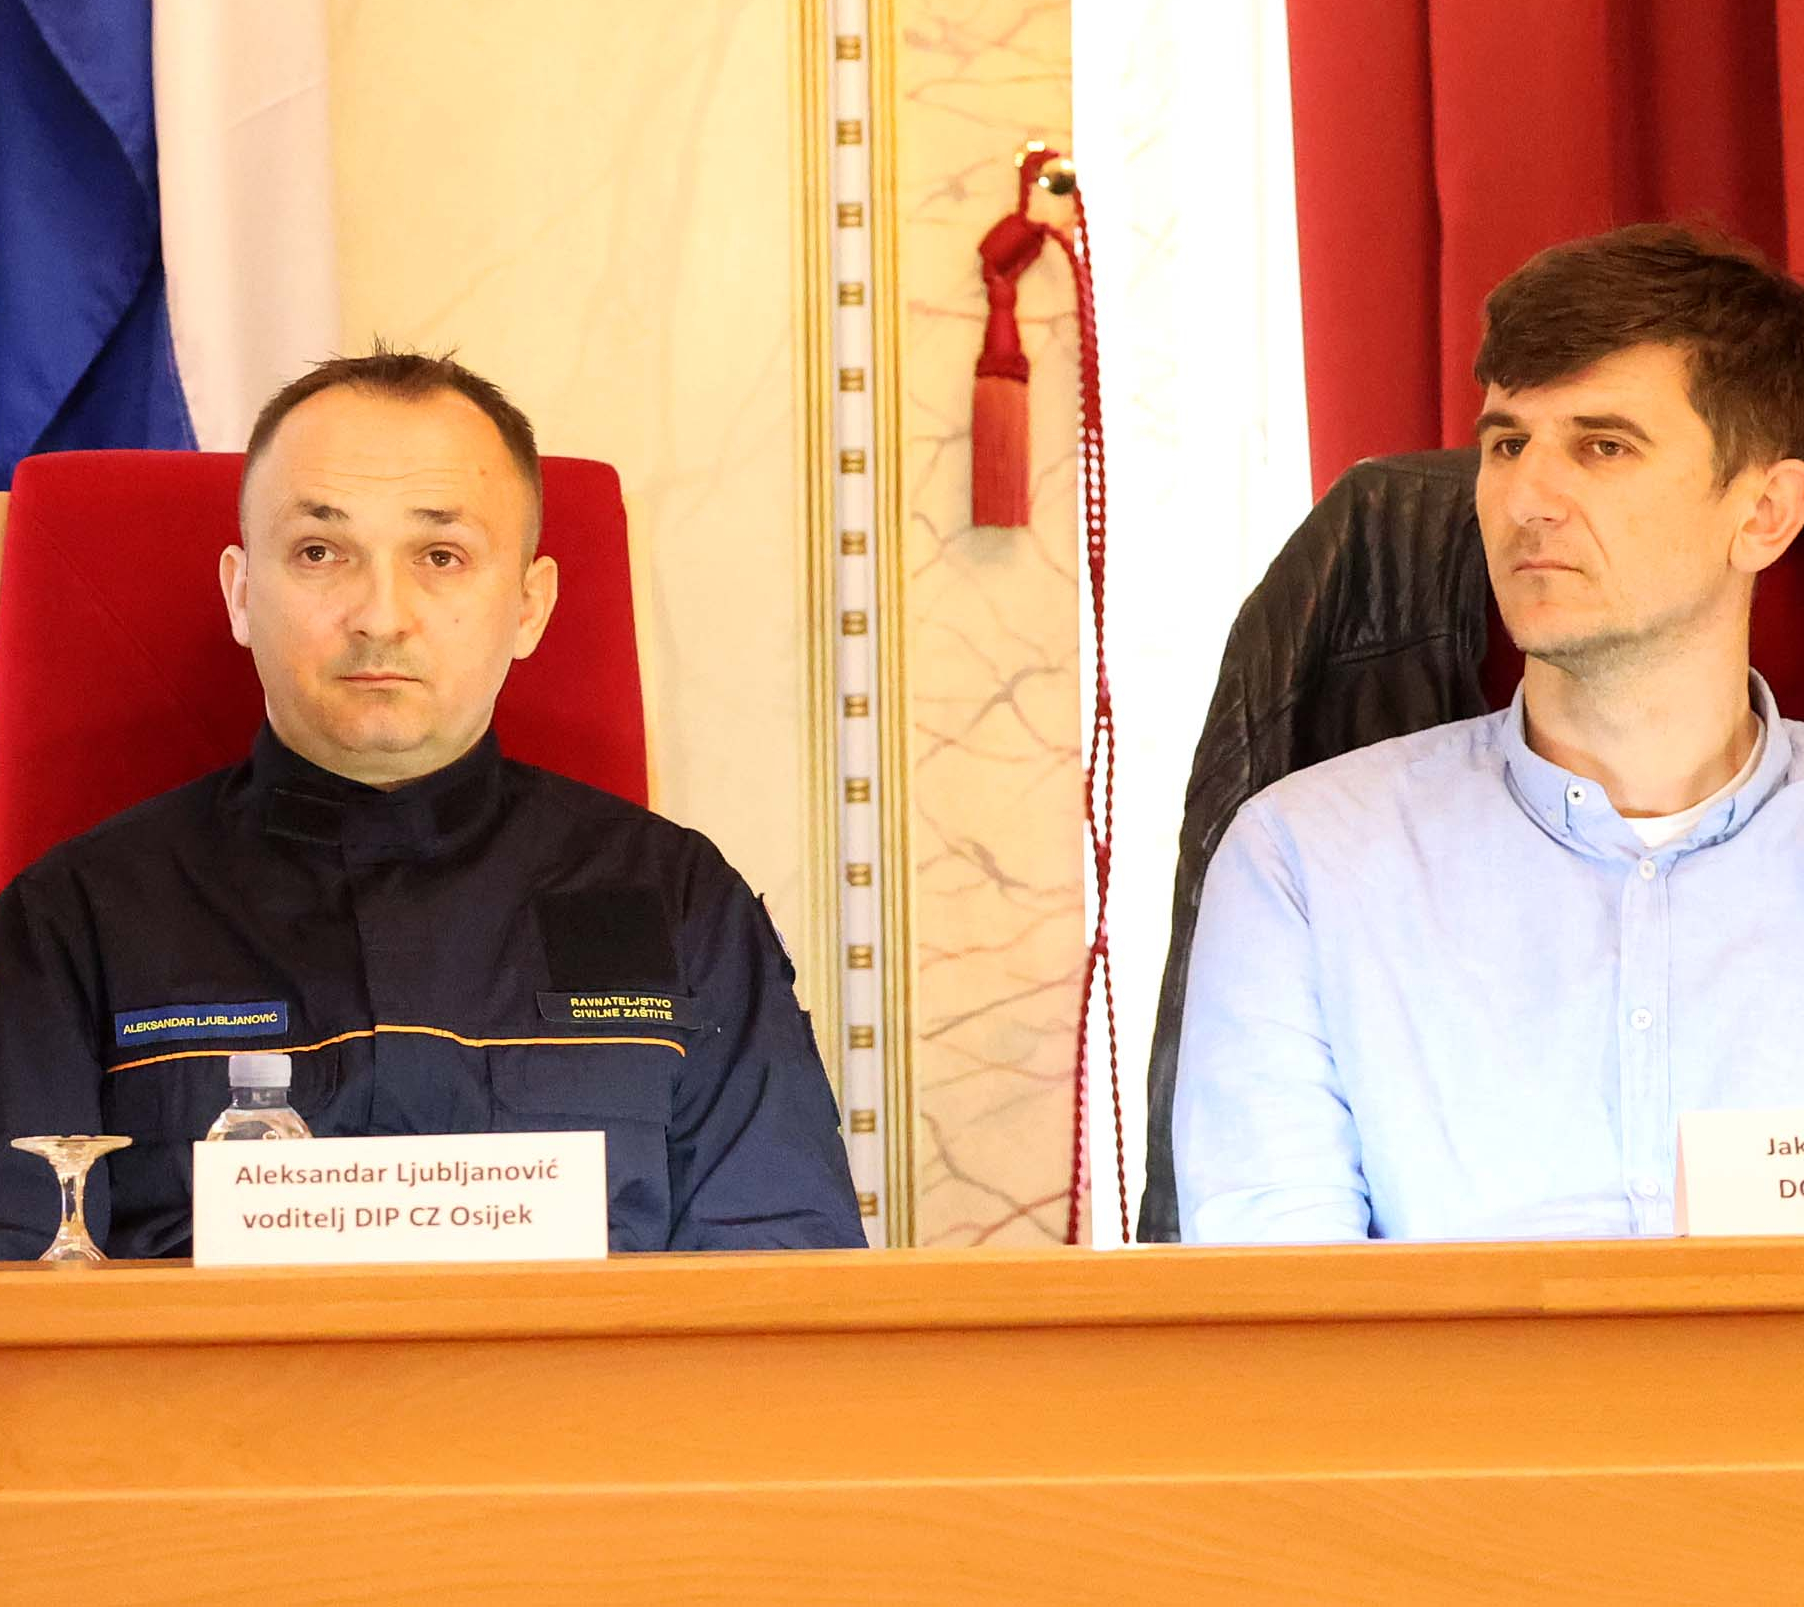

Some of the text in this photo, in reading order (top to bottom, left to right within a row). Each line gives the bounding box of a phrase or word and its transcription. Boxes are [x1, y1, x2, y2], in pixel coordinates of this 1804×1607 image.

[570, 996, 672, 1009] RAVNATELJSTVO
[572, 1007, 674, 1021] CIVILNE ZAŠTITE
[122, 1011, 278, 1035] ALEKSANDAR LJUBLJANOVIĆ
[236, 1158, 559, 1186] Aleksandar Ljubljanović
[243, 1204, 533, 1231] voditelj DIP CZ Osijek
